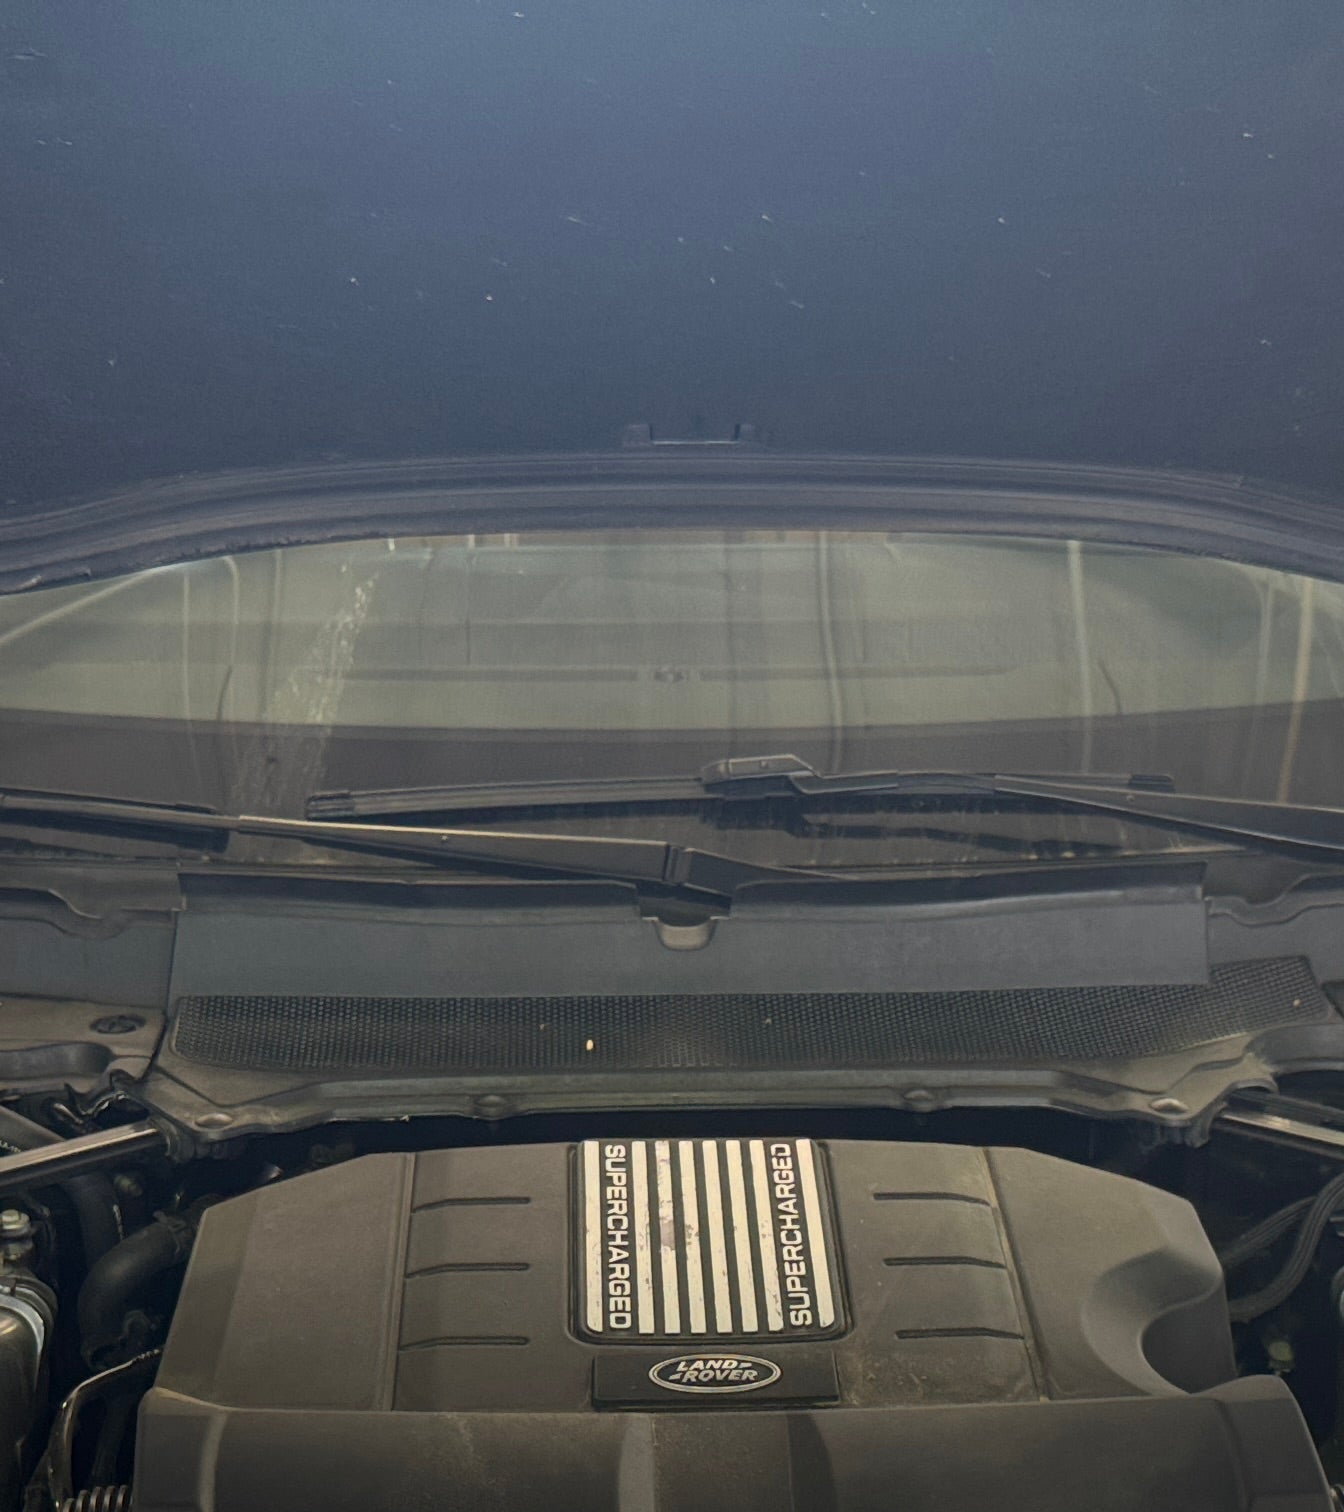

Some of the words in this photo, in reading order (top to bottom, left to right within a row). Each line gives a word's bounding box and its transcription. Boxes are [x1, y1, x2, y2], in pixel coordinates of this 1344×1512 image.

[605, 1143, 632, 1330] SUPERCHARGED
[770, 1142, 813, 1327] SUPERCHARGED
[677, 1359, 738, 1371] LAND
[679, 1368, 758, 1383] ROVER
